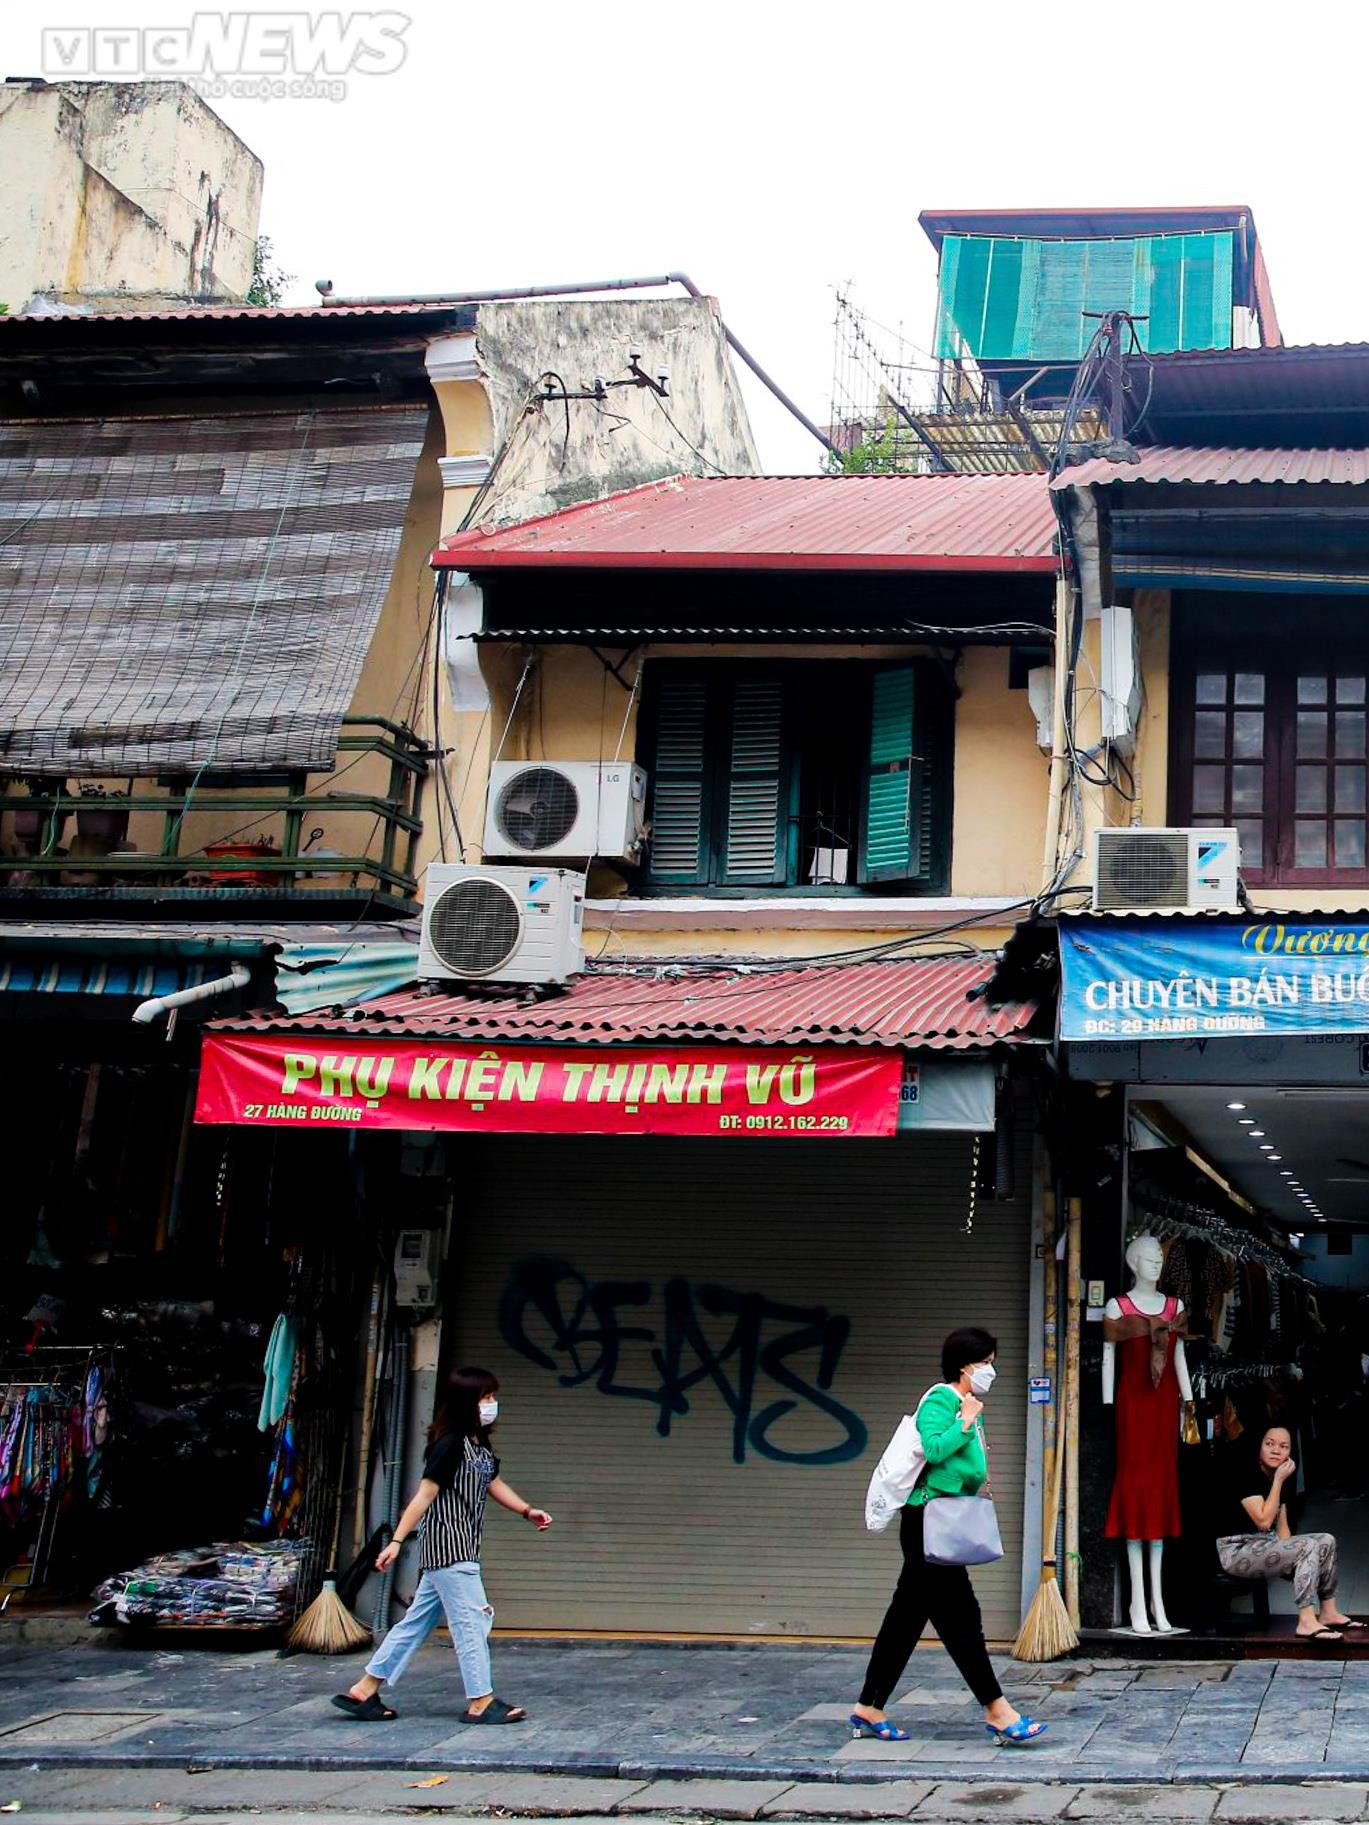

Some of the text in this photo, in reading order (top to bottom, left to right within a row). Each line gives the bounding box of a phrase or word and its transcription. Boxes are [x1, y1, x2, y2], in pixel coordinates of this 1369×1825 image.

[1085, 970, 1219, 1010] CHUYÊN
[1229, 967, 1299, 1007] BÁN
[1121, 1019, 1143, 1033] 29
[281, 1051, 818, 1113] PHỤ KIỆN THỊNH VŨ
[243, 1102, 364, 1122] 27 HÀNG ĐƯỜNG
[719, 1115, 849, 1131] ĐT: 0912.162.229
